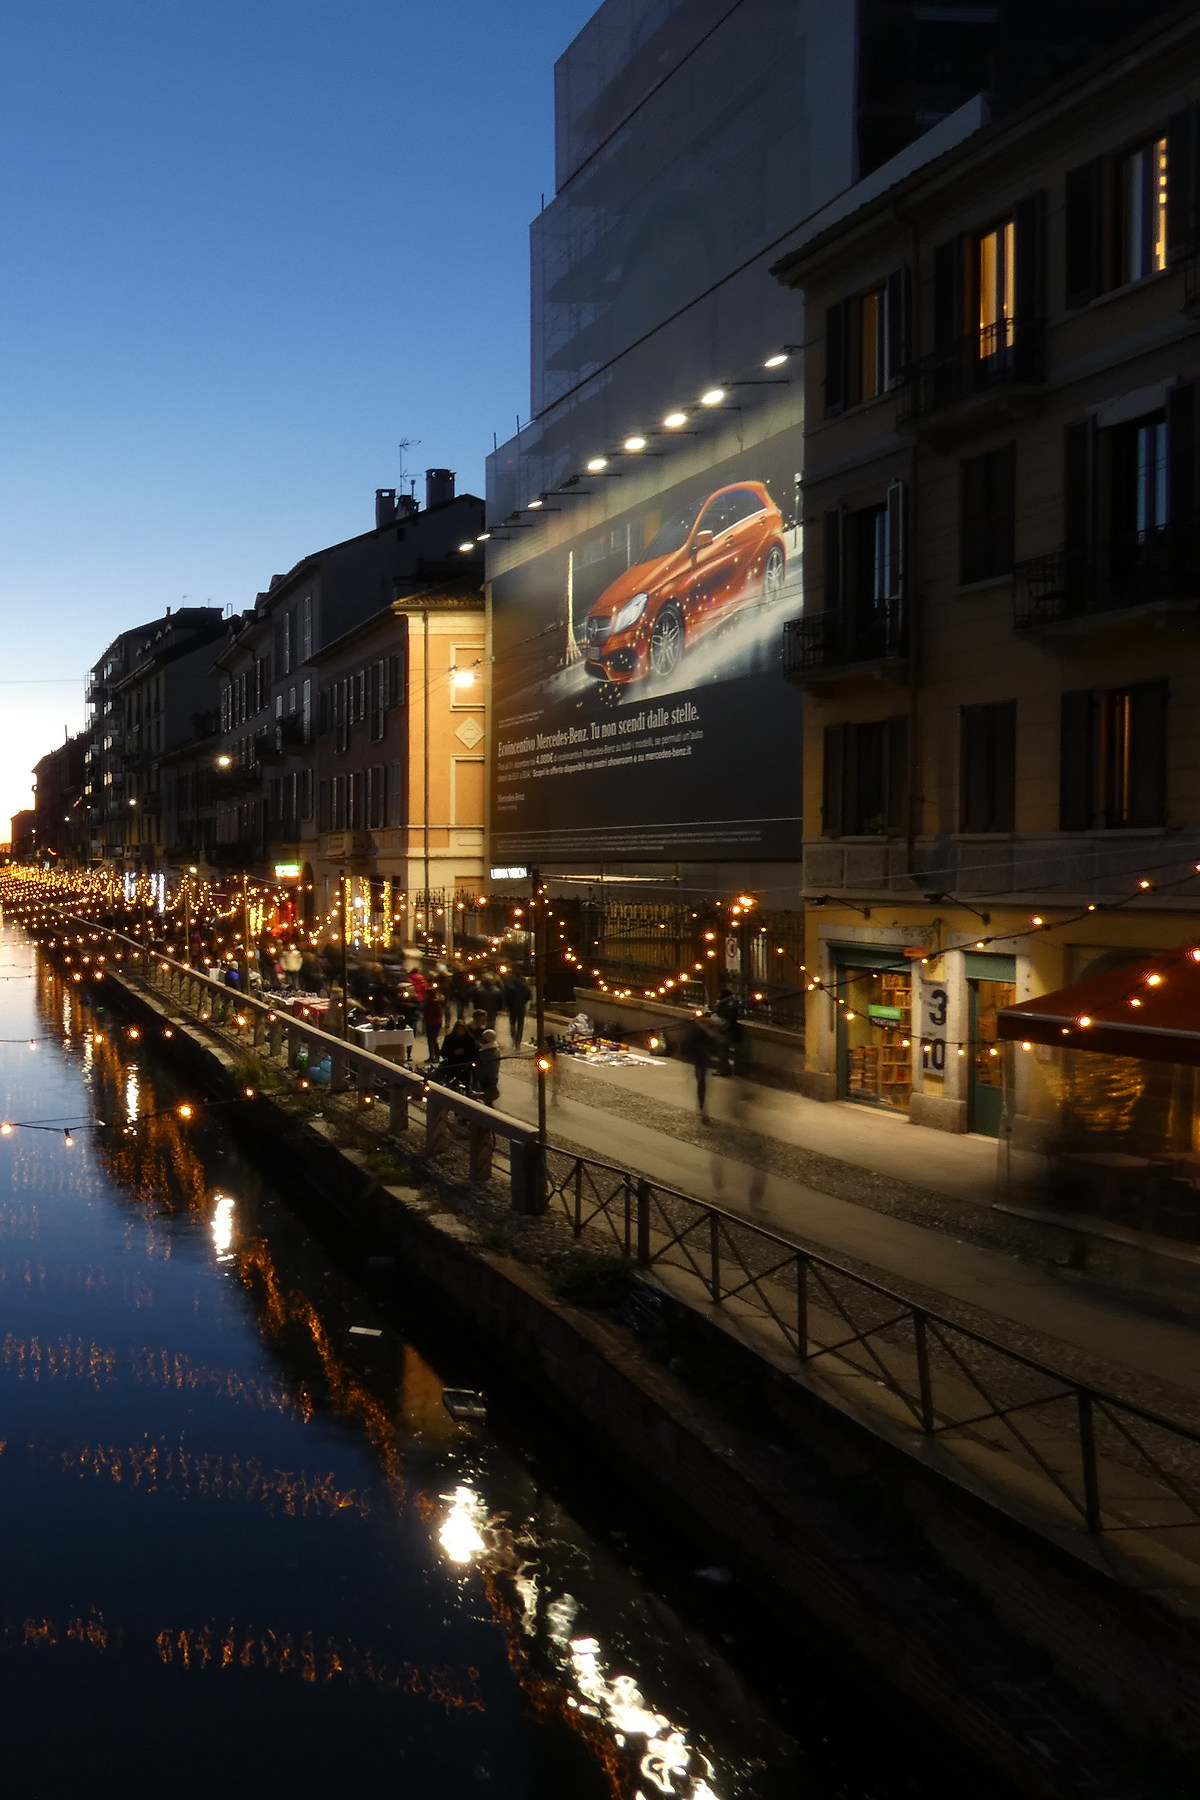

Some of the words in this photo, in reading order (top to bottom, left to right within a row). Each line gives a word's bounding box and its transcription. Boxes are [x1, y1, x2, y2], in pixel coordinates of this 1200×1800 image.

[536, 726, 589, 749] Mercedes-Benz.
[590, 721, 600, 739] Tu
[601, 721, 617, 738] non
[618, 711, 645, 735] scendi
[647, 708, 670, 729] dalle
[671, 702, 700, 725] stelle.
[929, 989, 948, 1026] 3
